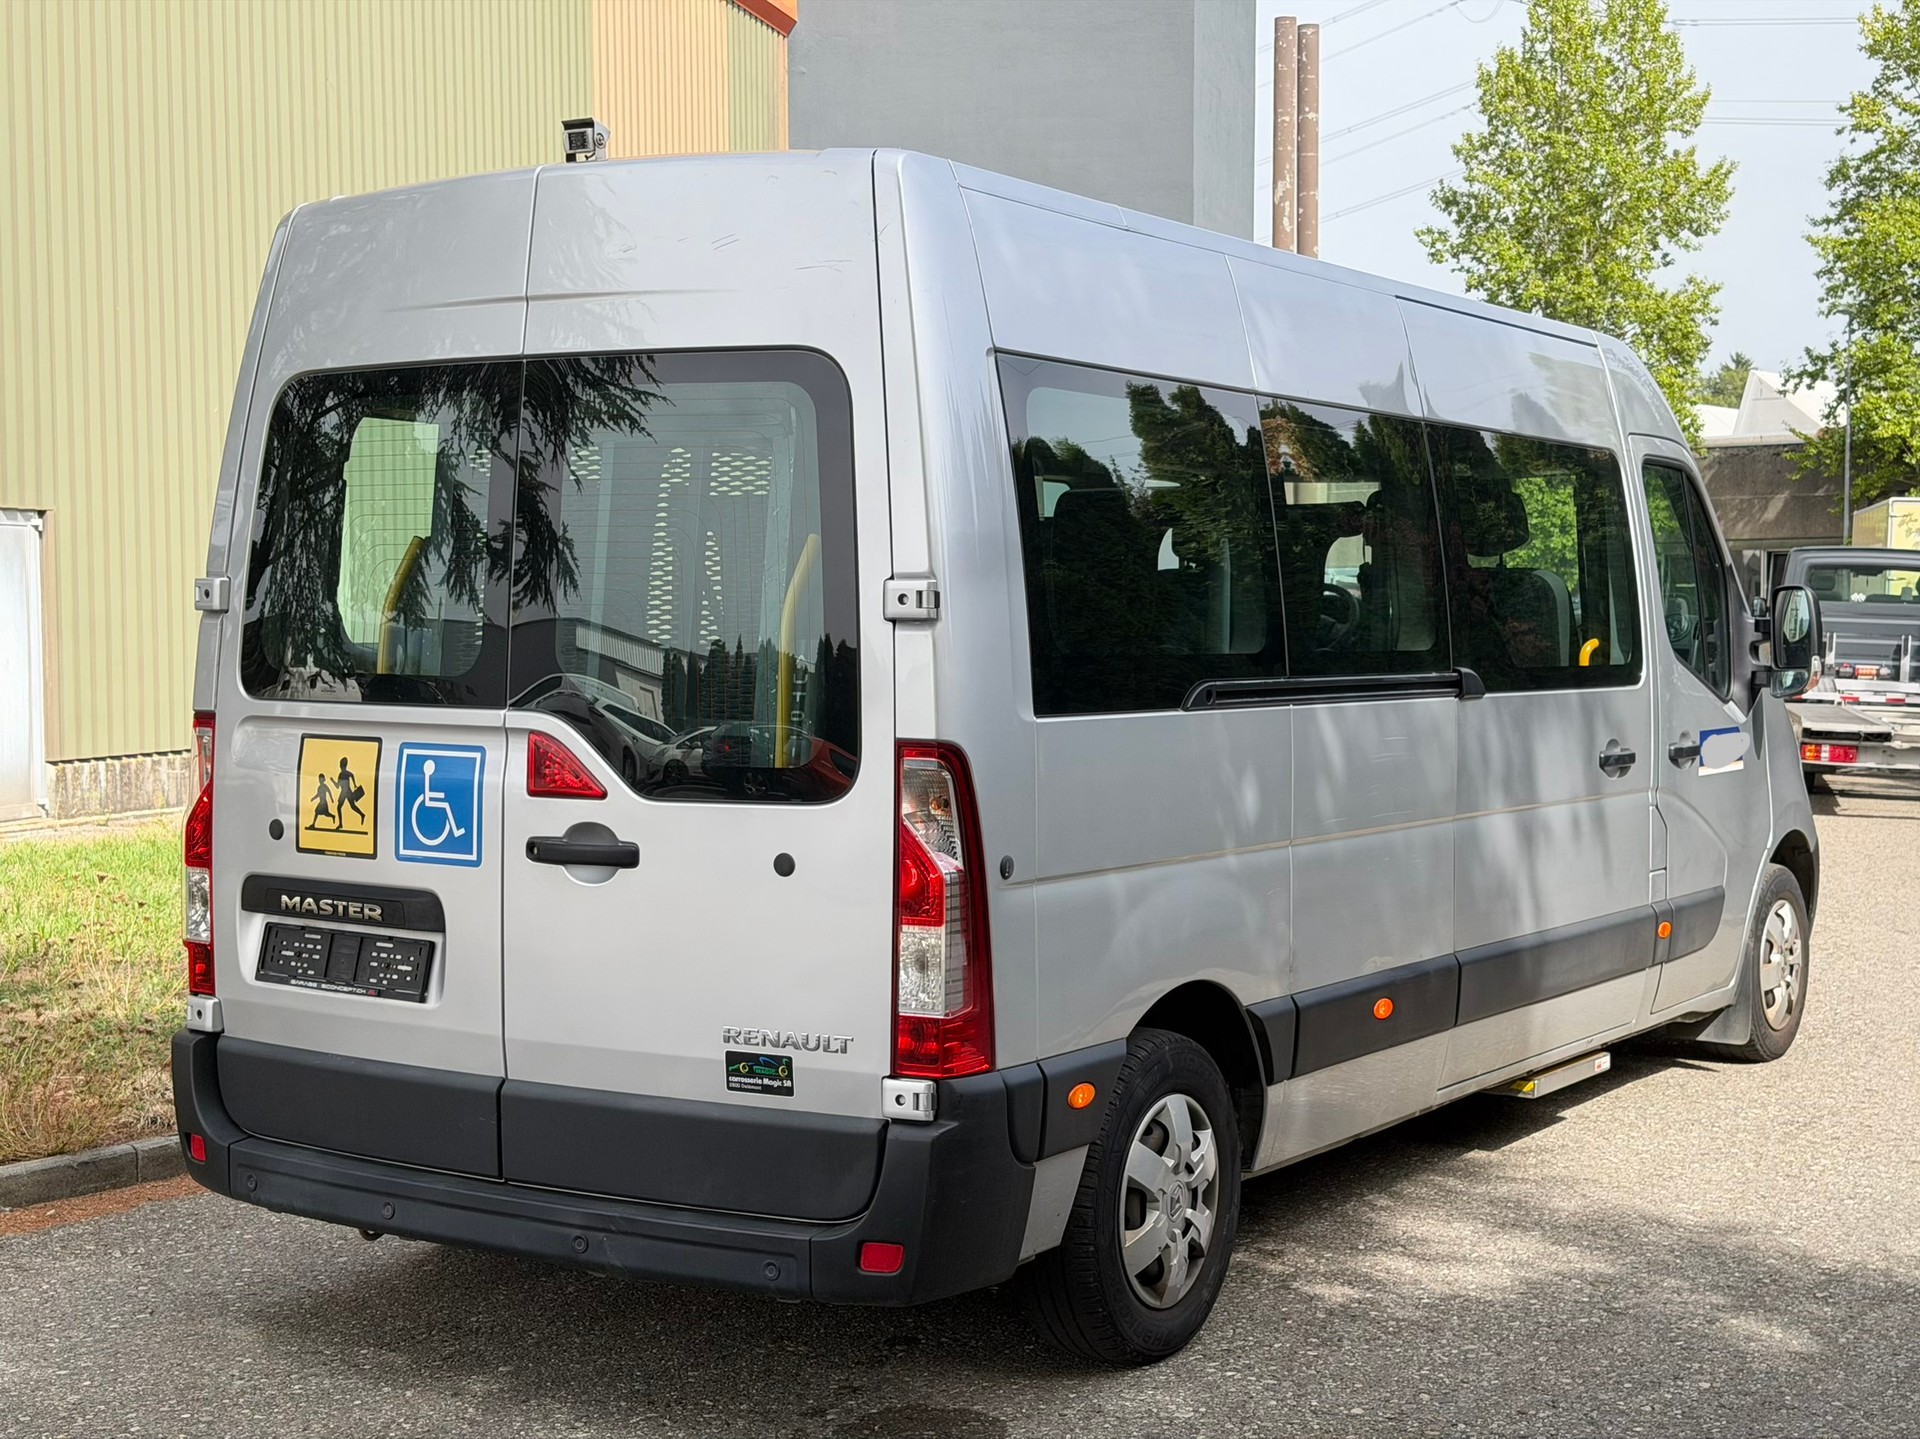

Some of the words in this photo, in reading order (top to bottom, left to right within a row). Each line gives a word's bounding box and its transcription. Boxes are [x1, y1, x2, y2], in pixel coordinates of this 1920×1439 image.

[280, 894, 383, 922] MASTER
[722, 1025, 854, 1054] RENAULT
[729, 1076, 762, 1084] carrosserie
[763, 1078, 782, 1088] Magic
